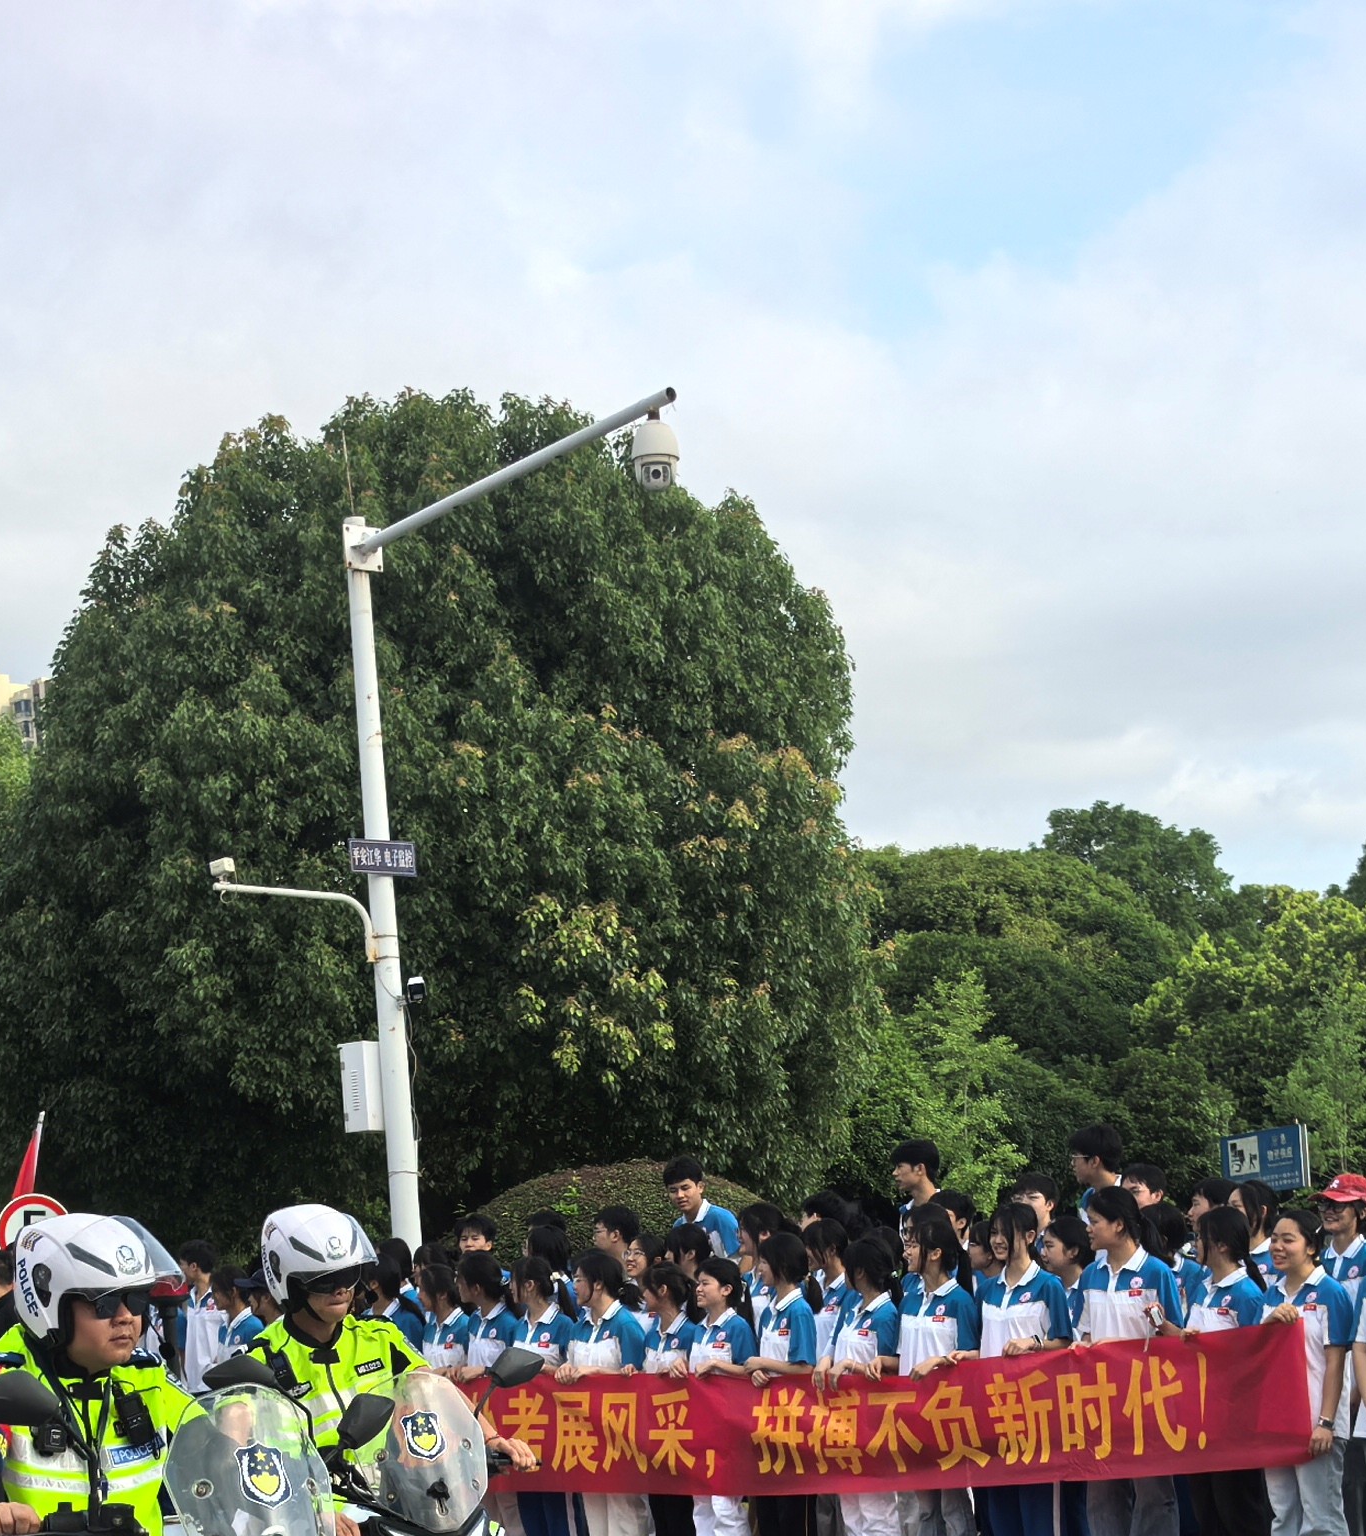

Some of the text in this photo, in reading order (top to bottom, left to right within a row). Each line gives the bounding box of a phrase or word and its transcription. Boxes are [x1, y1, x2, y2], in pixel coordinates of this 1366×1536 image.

[352, 846, 414, 868] 平安江华 电子监控
[17, 1257, 37, 1314] POLICE
[118, 1442, 153, 1461] POLICE
